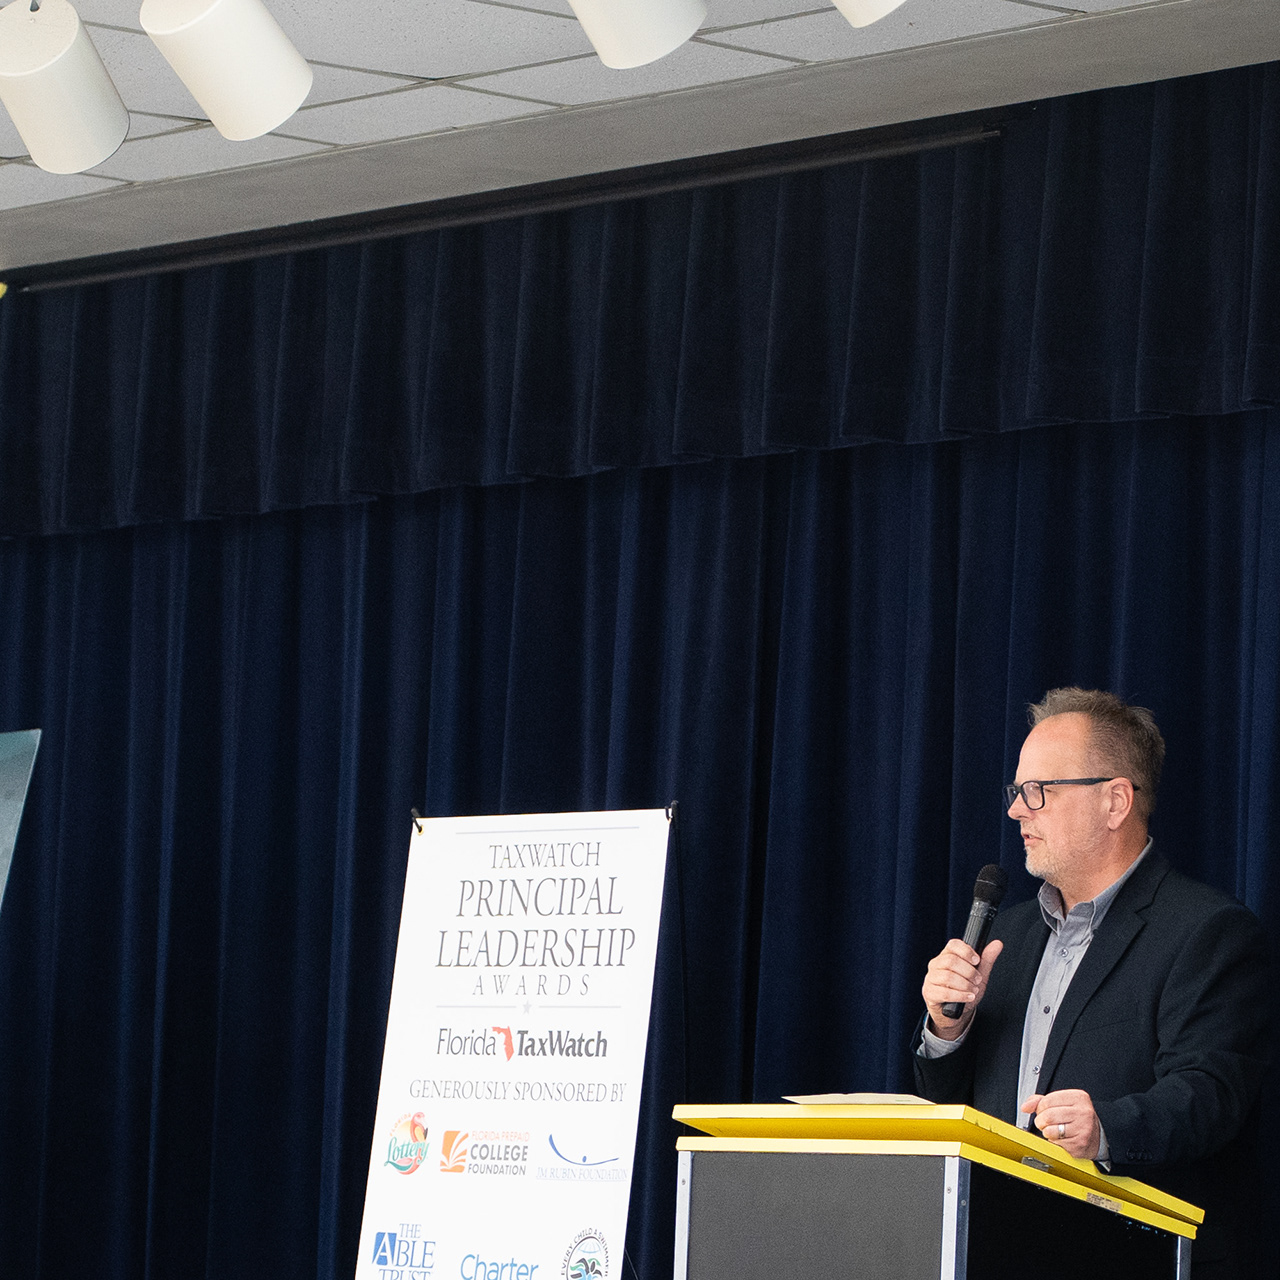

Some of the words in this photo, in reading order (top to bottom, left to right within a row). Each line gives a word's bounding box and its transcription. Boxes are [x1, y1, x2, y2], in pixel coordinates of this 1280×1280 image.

[488, 841, 602, 868] TAXWATCH
[455, 876, 624, 917] PRINCIPAL
[435, 928, 636, 968] LEADERSHIP
[472, 974, 591, 996] AWARDS
[436, 1028, 497, 1057] Florida
[517, 1029, 608, 1057] TaxWatch
[409, 1079, 512, 1101] GENEROUSLY
[514, 1080, 608, 1102] SPONSORED
[610, 1083, 627, 1103] BY
[471, 1130, 499, 1141] FLORIDA
[501, 1131, 530, 1142] PREPAID
[383, 1136, 430, 1167] Lottery
[470, 1143, 529, 1161] COLLEGE
[468, 1163, 527, 1176] FOUNDATION
[549, 1167, 577, 1179] RUBIN
[399, 1223, 422, 1239] THE
[574, 1227, 593, 1244] CHILD
[372, 1231, 436, 1269] ABLE
